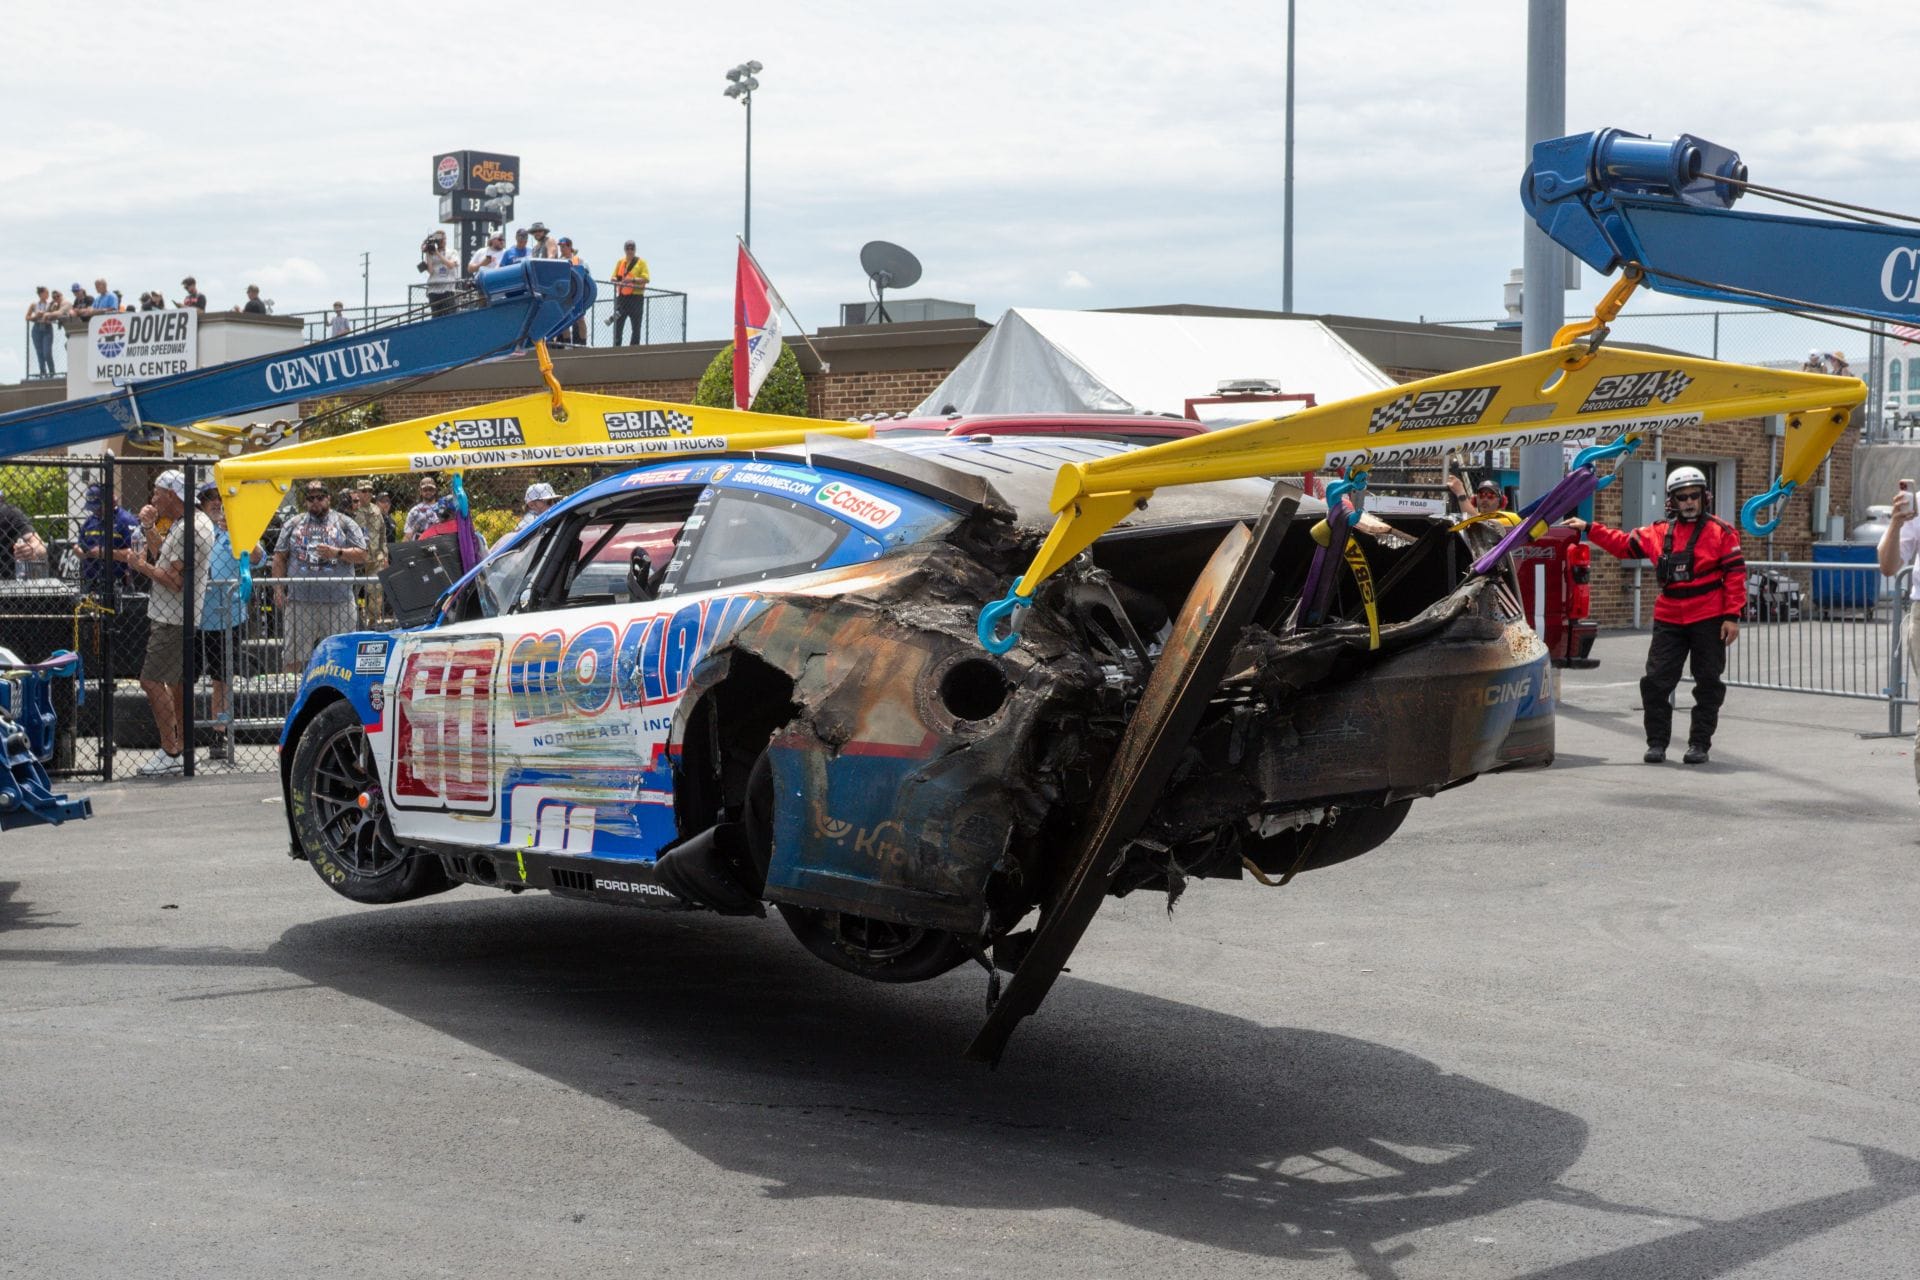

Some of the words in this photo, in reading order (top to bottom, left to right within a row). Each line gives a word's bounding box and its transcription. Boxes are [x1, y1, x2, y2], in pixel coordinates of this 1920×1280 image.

[472, 164, 514, 182] RIVERS
[482, 160, 501, 170] BET
[128, 312, 189, 344] DOVER
[126, 345, 149, 357] MOTOR
[150, 343, 186, 355] SPEEDWAY
[97, 362, 136, 378] MEDIA
[139, 360, 188, 376] CENTER
[265, 338, 393, 393] CENTURY
[1580, 399, 1632, 412] PRODUCTS
[1400, 415, 1458, 430] PRODUCTS
[459, 438, 507, 449] PRODUCTS
[610, 430, 655, 440] PRODUCTS
[414, 454, 457, 468] SLOW
[461, 450, 506, 465] DOWN
[521, 447, 562, 460] MOVE
[566, 444, 603, 457] OVER
[608, 442, 635, 455] FOR
[639, 440, 668, 452] TOW
[673, 437, 725, 450] TRUCKS
[732, 471, 814, 496] SUBMARINES.COM
[832, 490, 895, 525] Castrol
[533, 722, 638, 747] NORTHEAST,
[595, 879, 629, 892] FORD
[631, 883, 677, 898] RACIN
